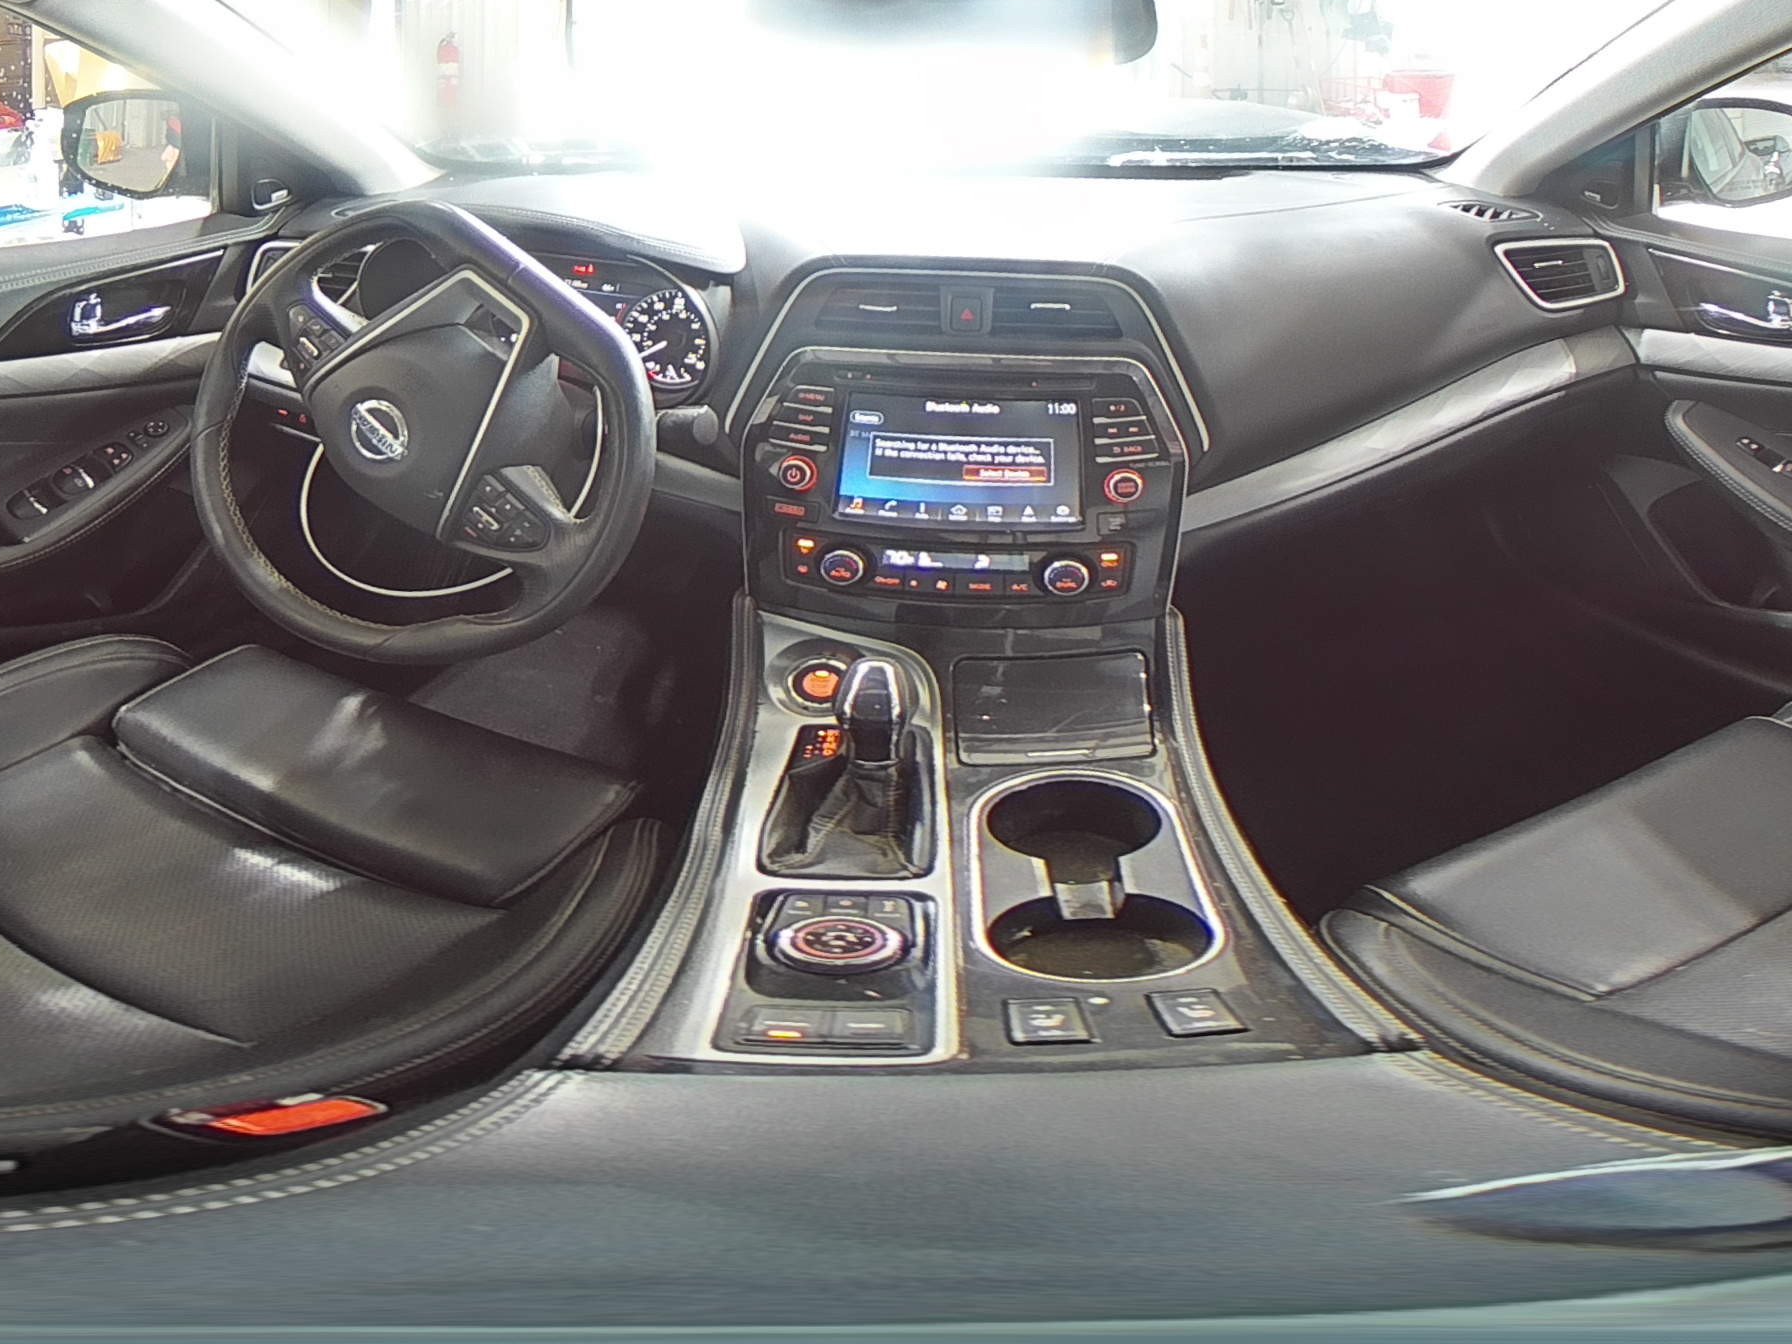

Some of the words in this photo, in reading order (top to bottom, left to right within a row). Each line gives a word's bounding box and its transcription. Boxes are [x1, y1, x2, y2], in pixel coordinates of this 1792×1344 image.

[925, 400, 970, 414] Bluetooth
[971, 402, 1001, 415] Audio
[1047, 402, 1077, 415] 11:00
[352, 406, 399, 454] NISSAN
[874, 437, 916, 451] Searching
[916, 440, 930, 450] for
[937, 442, 978, 453] Bluetooth
[979, 443, 1006, 454] Audio
[883, 448, 899, 457] the
[899, 449, 945, 460] connection
[968, 452, 992, 462] check
[993, 455, 1014, 464] your
[979, 468, 1003, 478] Select
[1003, 469, 1030, 478] Device
